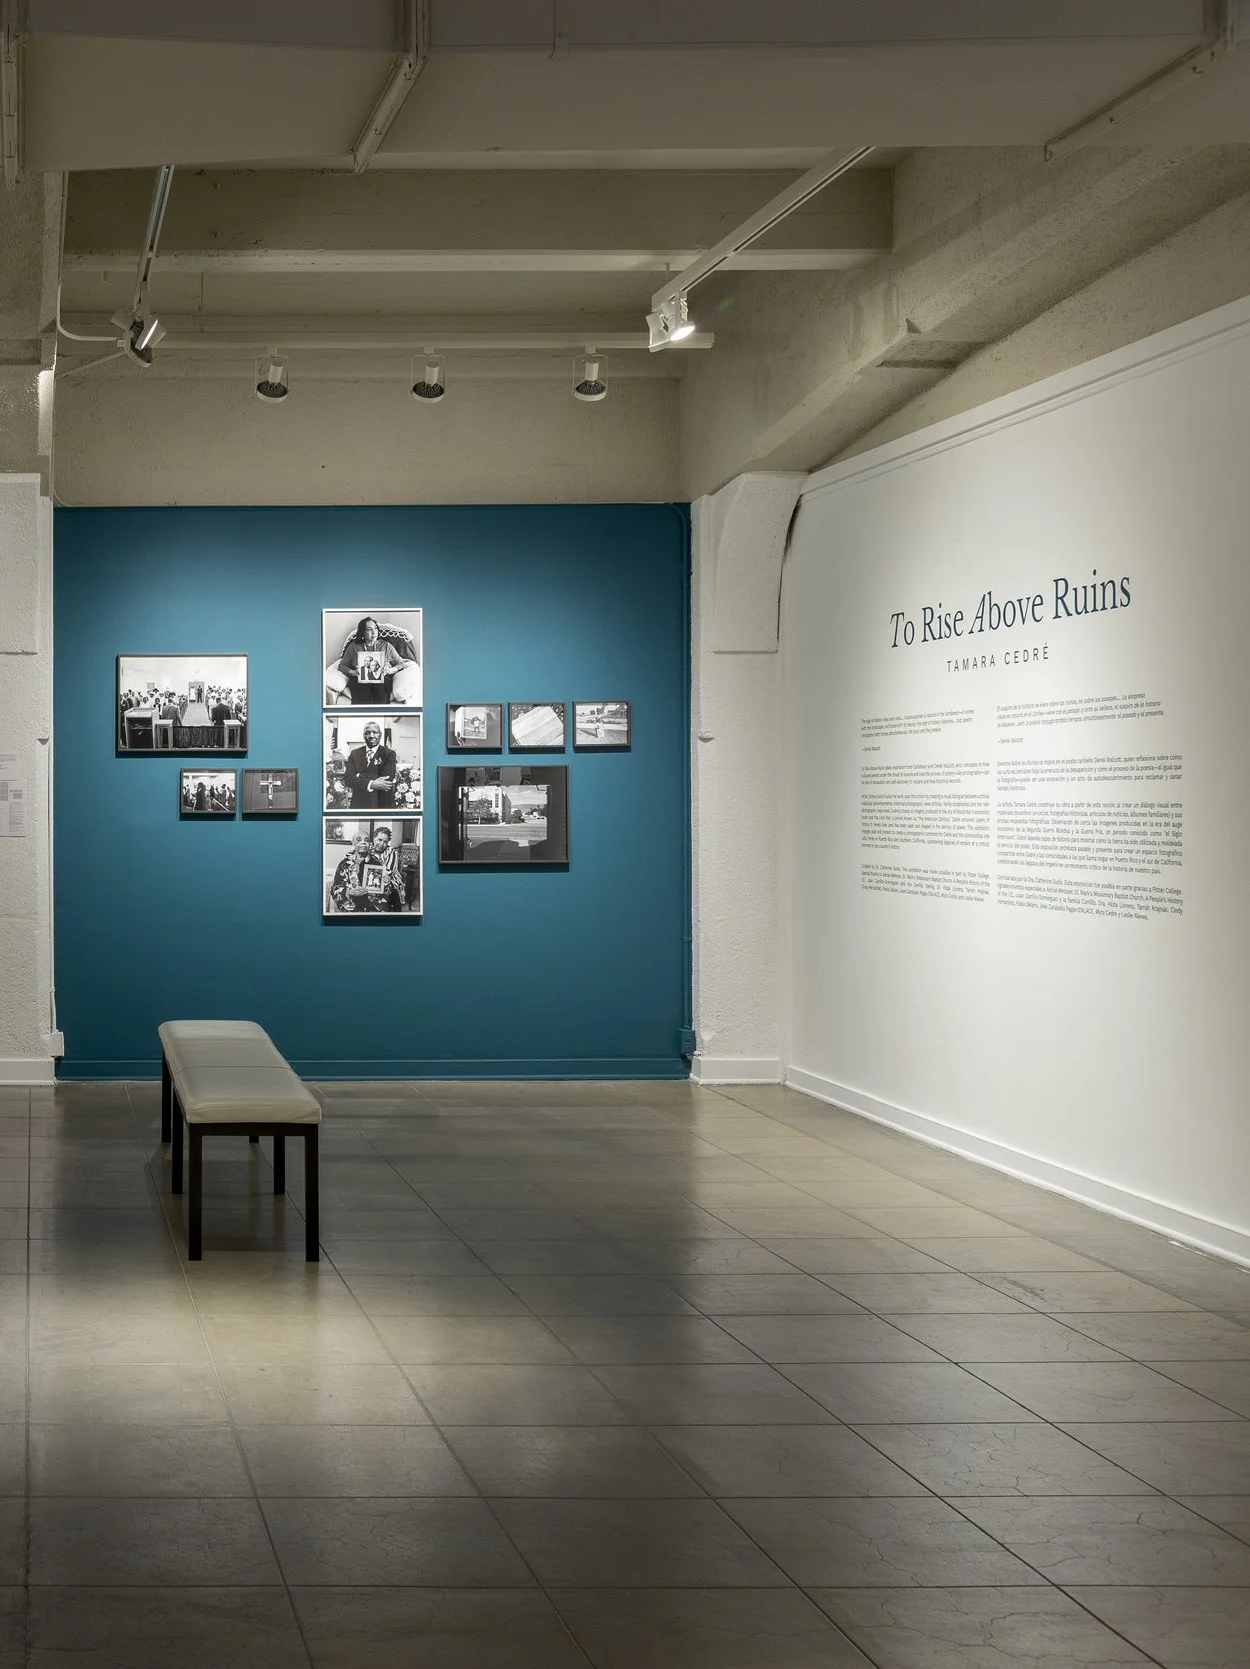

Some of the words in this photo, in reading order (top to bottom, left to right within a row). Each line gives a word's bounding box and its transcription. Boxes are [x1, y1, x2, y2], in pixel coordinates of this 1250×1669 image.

[890, 612, 915, 648] To
[921, 602, 964, 643] Rise
[968, 590, 1044, 634] Above
[1052, 569, 1132, 620] Ruins
[947, 654, 996, 673] TAMARA
[1004, 642, 1049, 665] CEDRÉ
